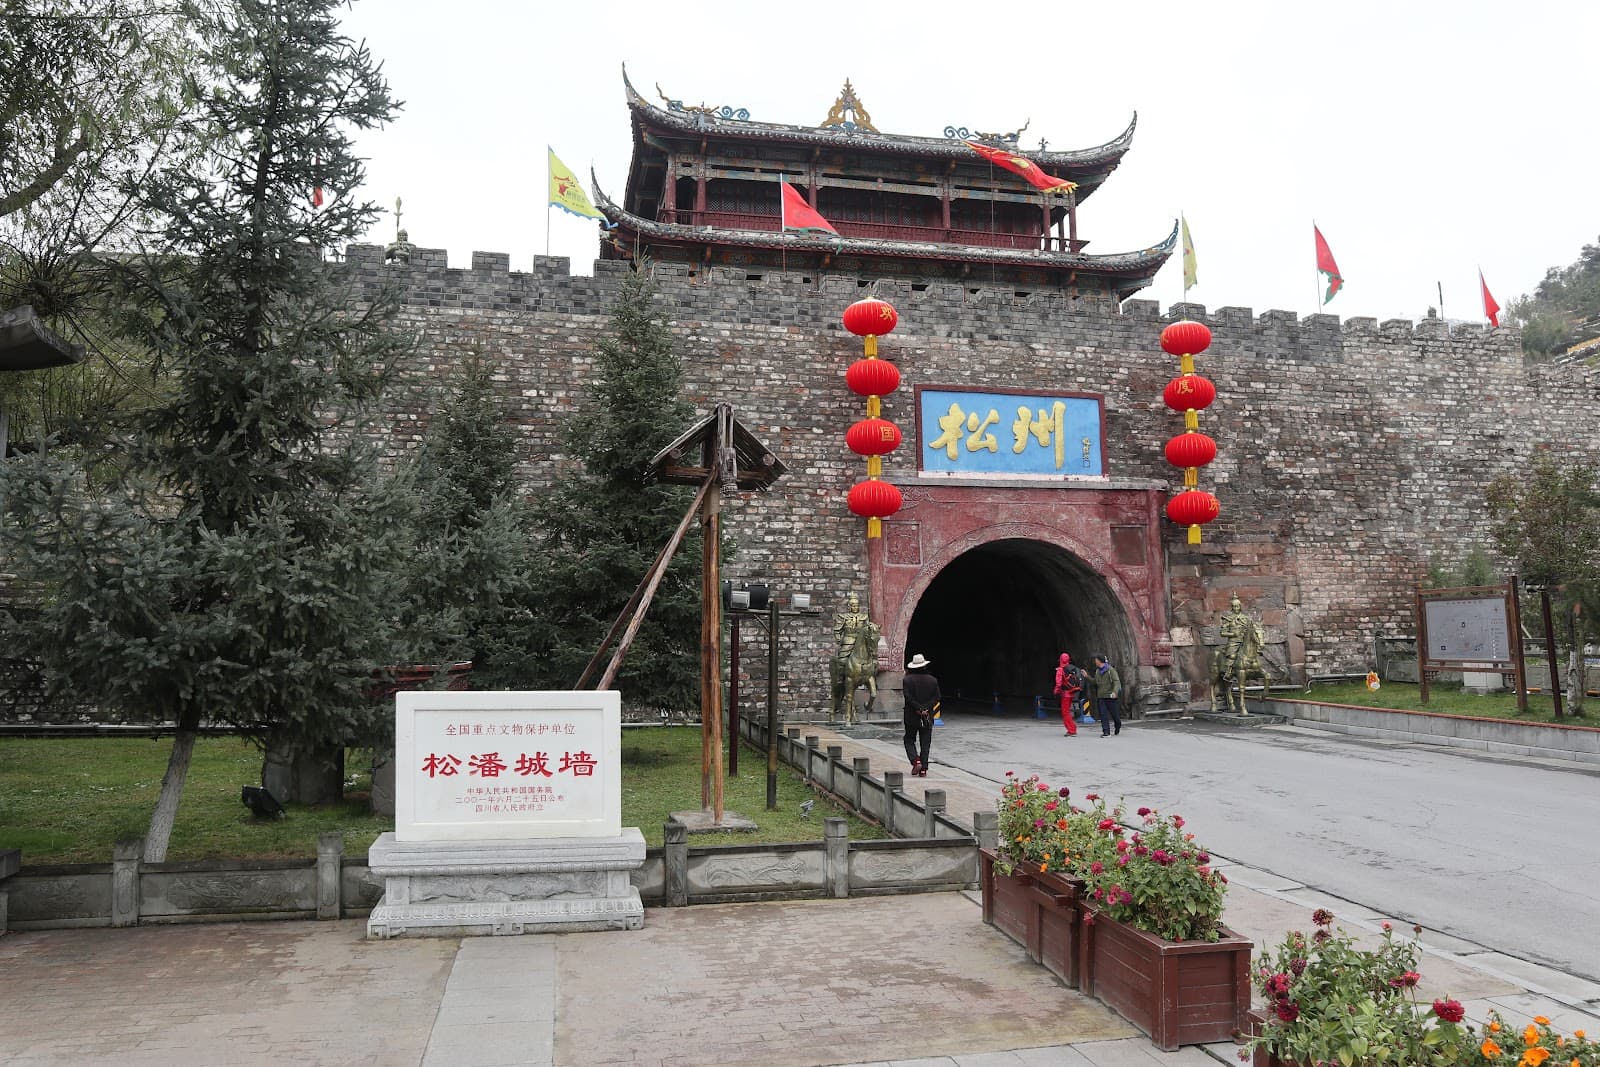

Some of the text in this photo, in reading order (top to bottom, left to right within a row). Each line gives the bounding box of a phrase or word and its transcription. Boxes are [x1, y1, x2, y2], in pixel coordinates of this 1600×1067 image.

[880, 426, 895, 441] 国
[928, 401, 1067, 470] 松州
[445, 723, 576, 737] 全国重点文物保护单位
[421, 751, 598, 778] 松潘城墙
[466, 786, 553, 796] 中华人民共和国国务院
[475, 803, 545, 813] 四川省人民政府立
